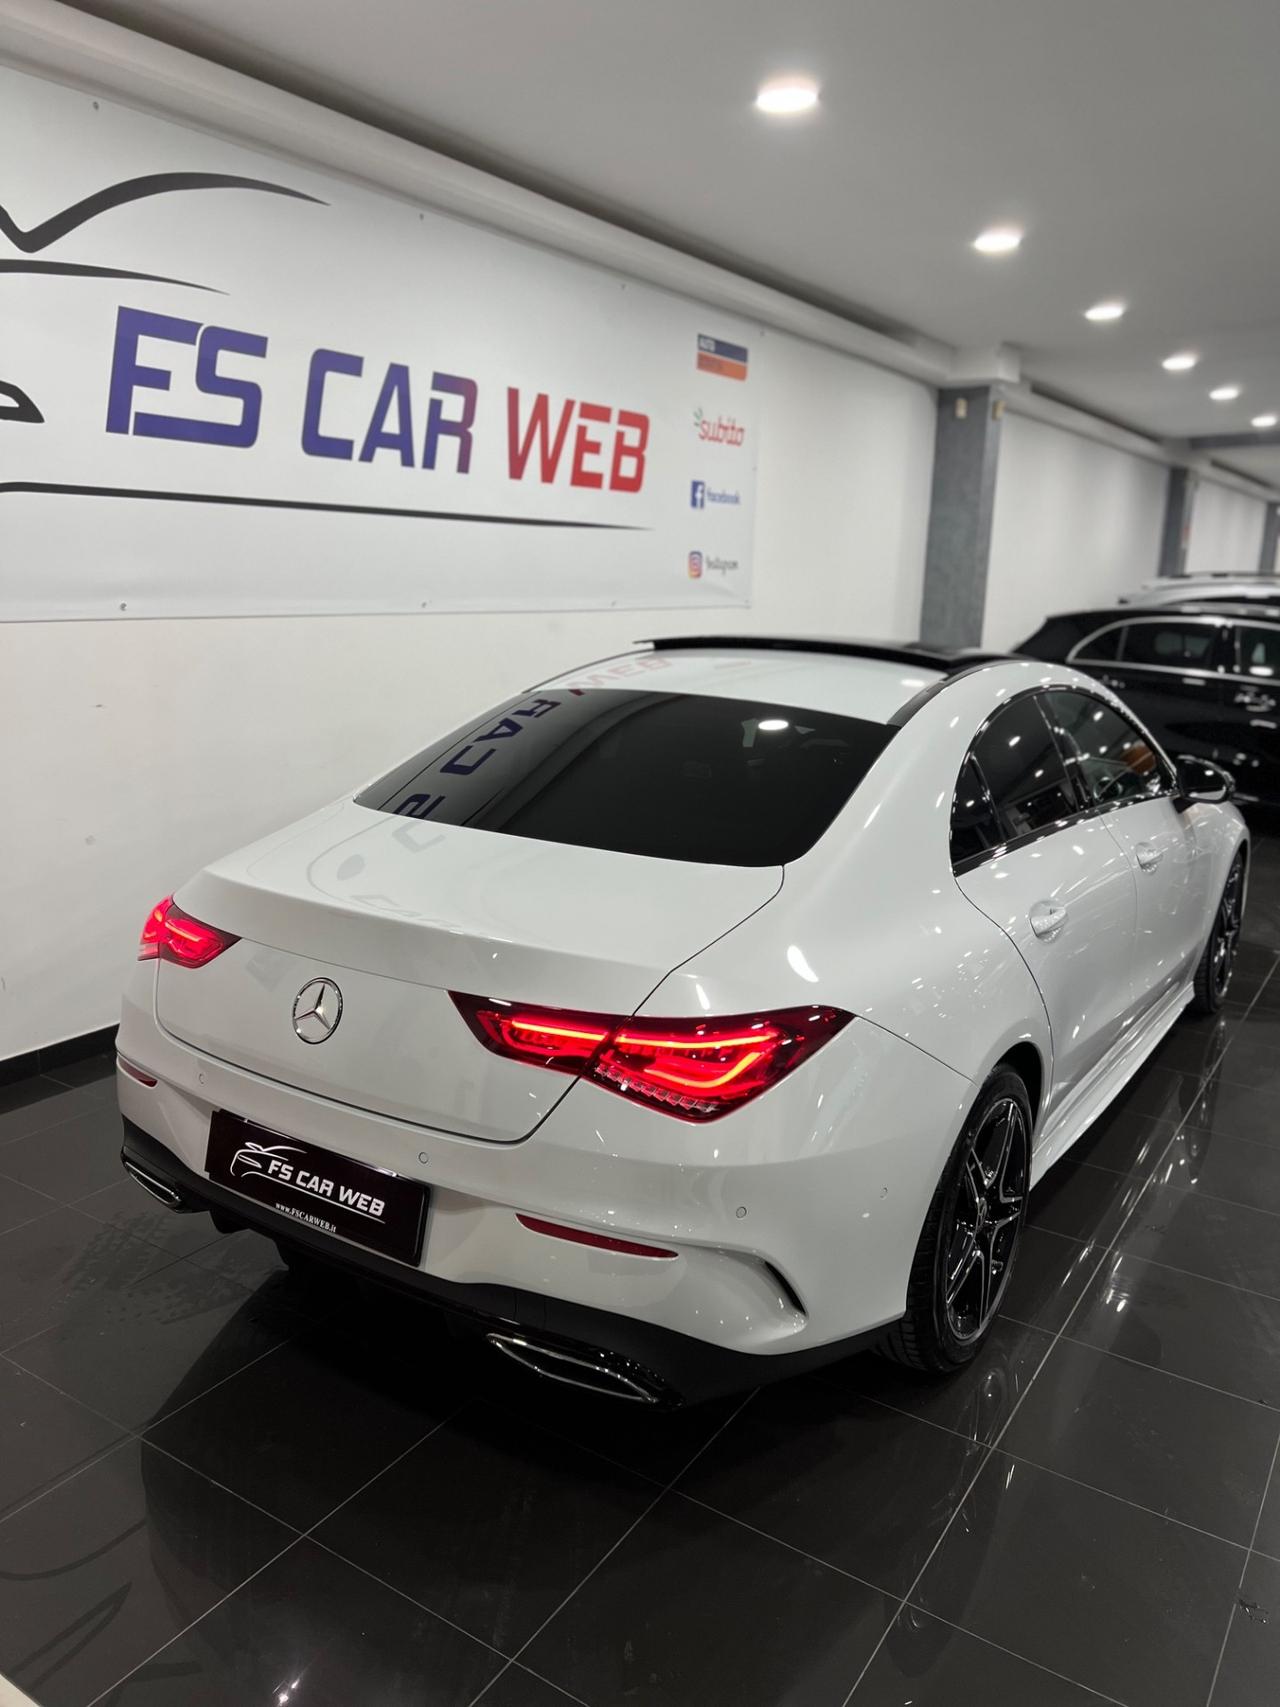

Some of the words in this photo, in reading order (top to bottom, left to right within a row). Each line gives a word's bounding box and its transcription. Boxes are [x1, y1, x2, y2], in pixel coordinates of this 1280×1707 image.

[301, 348, 478, 474] CAR
[506, 386, 650, 494] WEB
[698, 415, 744, 446] subito
[267, 1159, 294, 1181] FS
[295, 1170, 334, 1198] CAR
[339, 1185, 386, 1217] WEB
[275, 1203, 336, 1233] www.FSCARWEB.it
